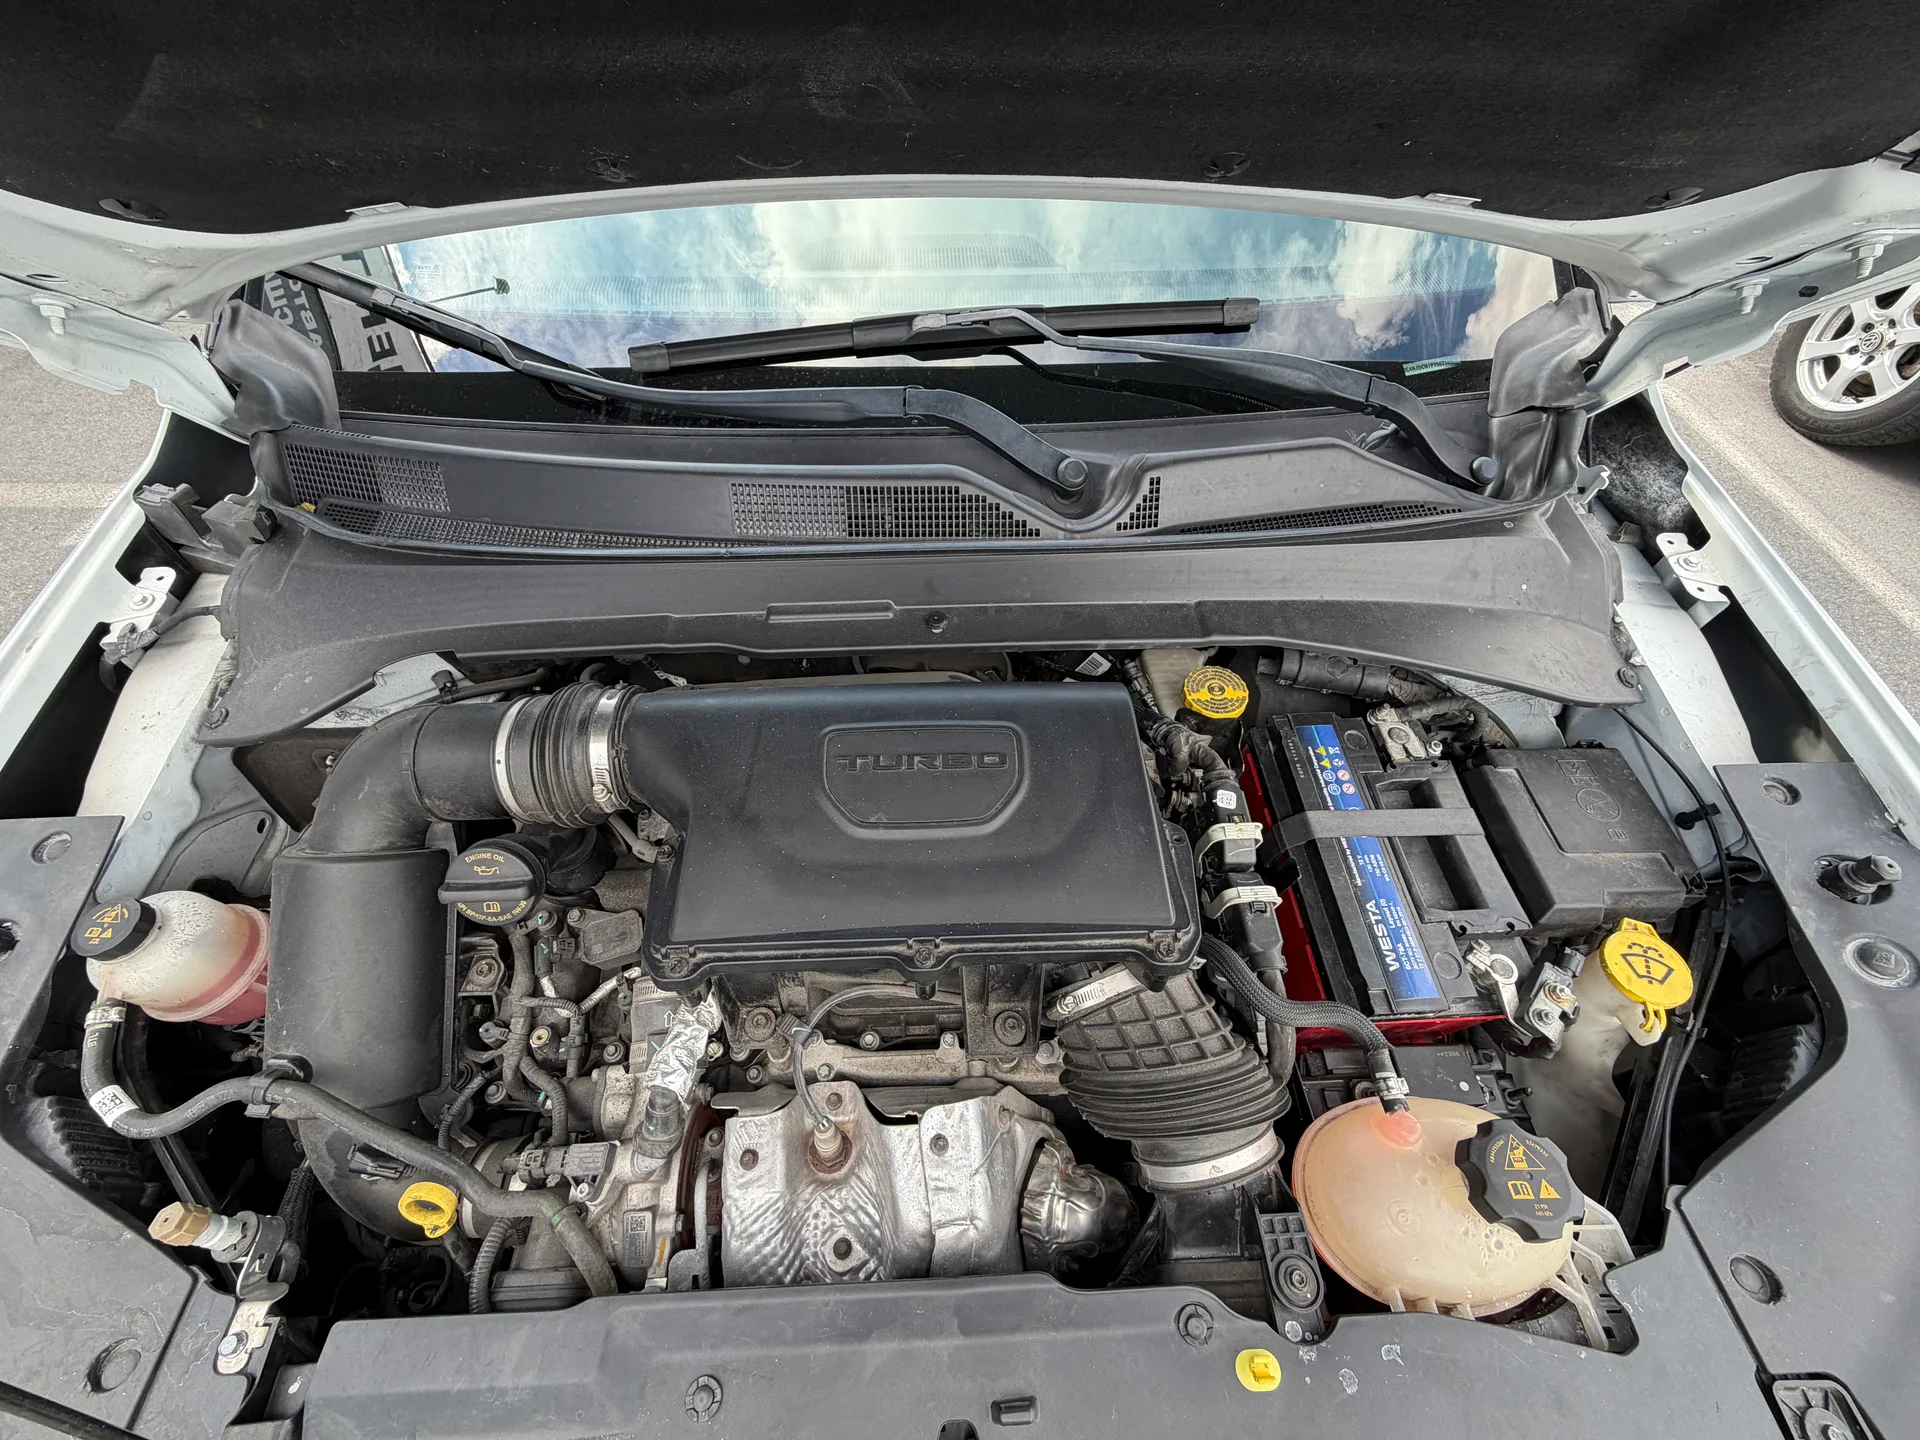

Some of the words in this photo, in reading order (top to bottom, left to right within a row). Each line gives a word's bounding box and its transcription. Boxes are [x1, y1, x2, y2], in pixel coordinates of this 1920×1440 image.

[837, 753, 1009, 772] TURBO
[465, 852, 492, 863] ENGINE
[492, 854, 505, 863] OIL
[1383, 906, 1396, 929] Layout
[1366, 900, 1400, 971] WESTA
